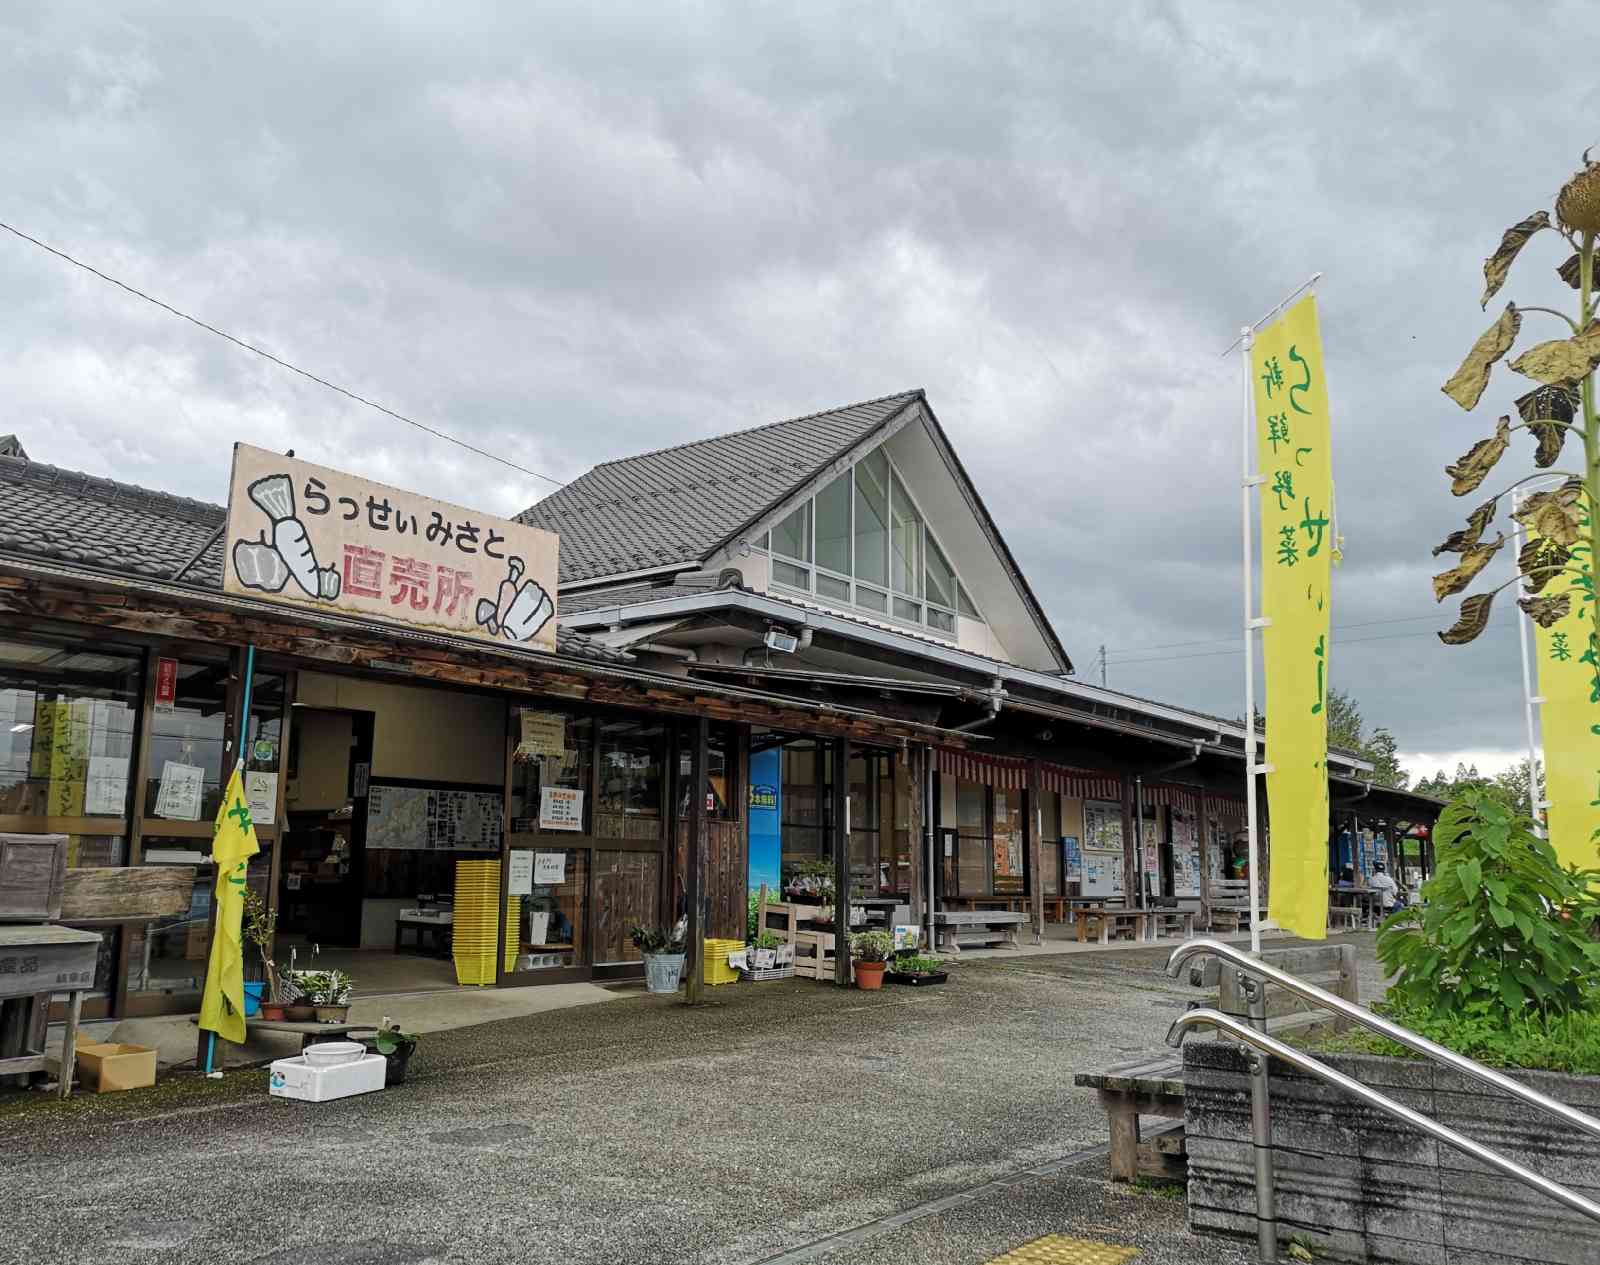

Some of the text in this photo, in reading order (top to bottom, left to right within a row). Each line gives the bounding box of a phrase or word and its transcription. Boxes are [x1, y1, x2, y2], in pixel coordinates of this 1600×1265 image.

[303, 476, 506, 560] らっせいみさと
[342, 542, 476, 617] 直売所
